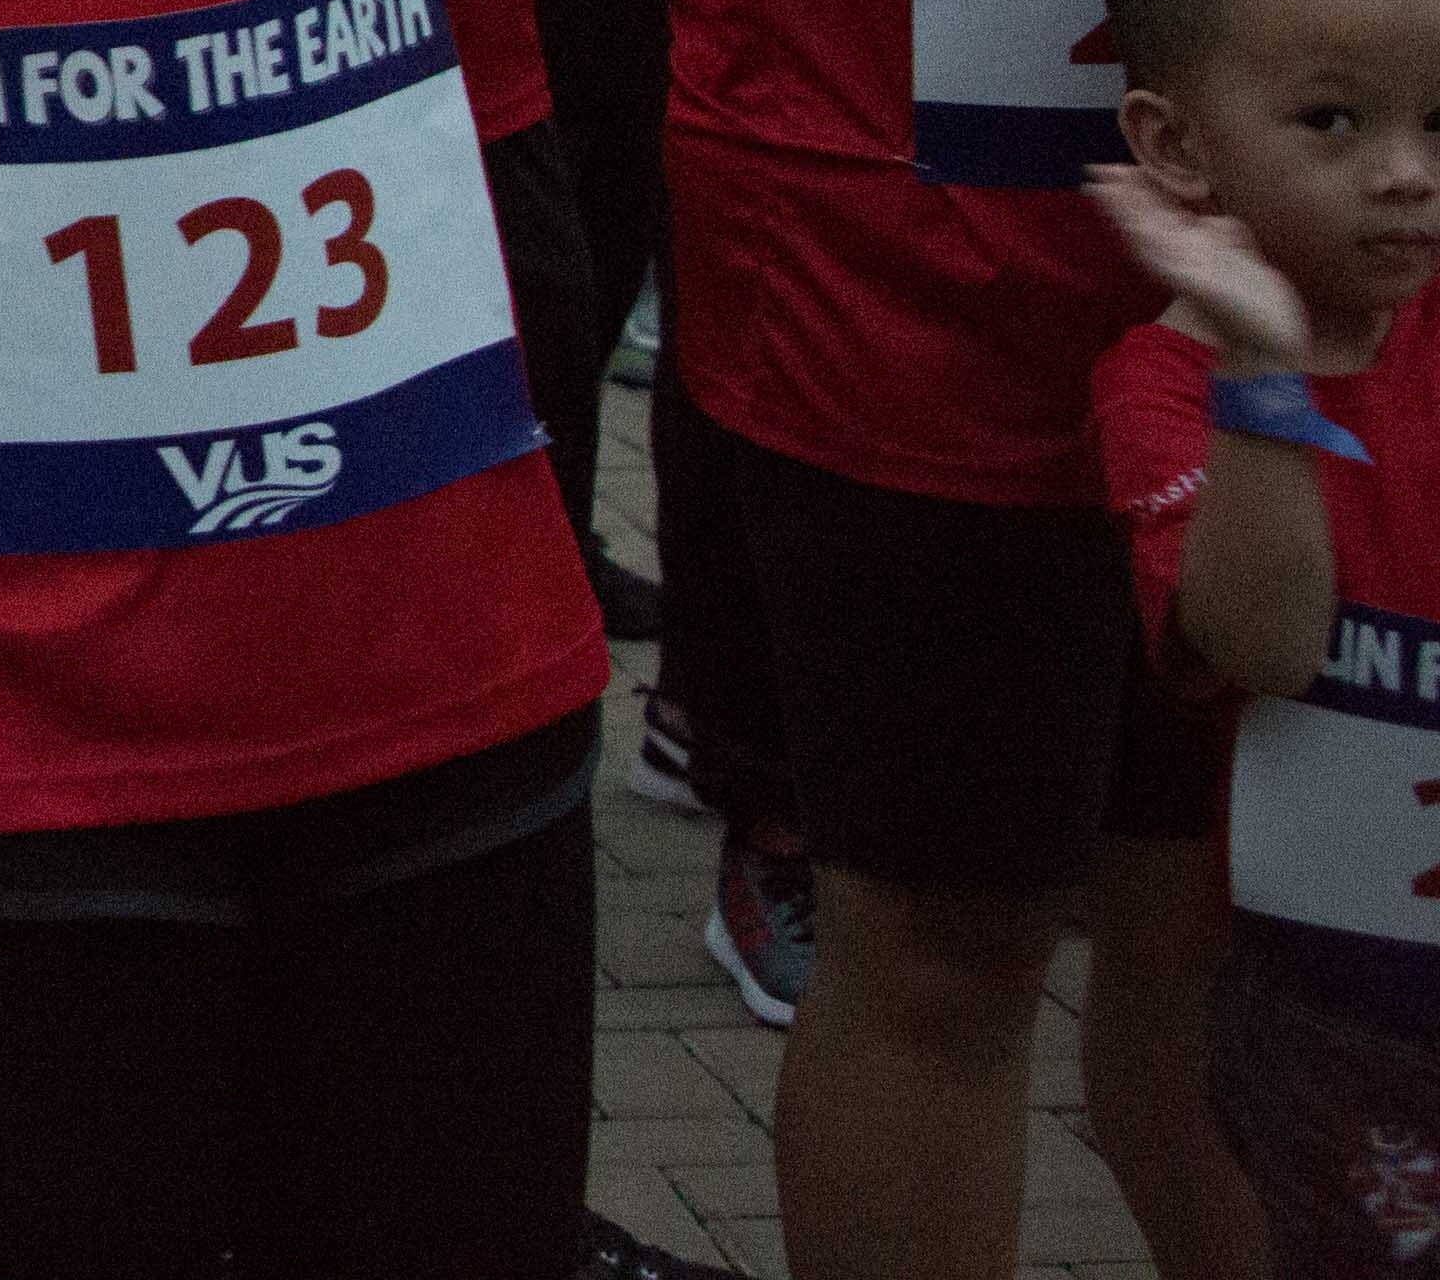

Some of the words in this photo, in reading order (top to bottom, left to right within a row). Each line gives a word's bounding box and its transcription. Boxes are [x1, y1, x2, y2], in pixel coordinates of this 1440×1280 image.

[21, 44, 166, 127] FOR
[174, 17, 292, 114] THE
[44, 168, 389, 374] 123
[157, 421, 344, 514] VUS
